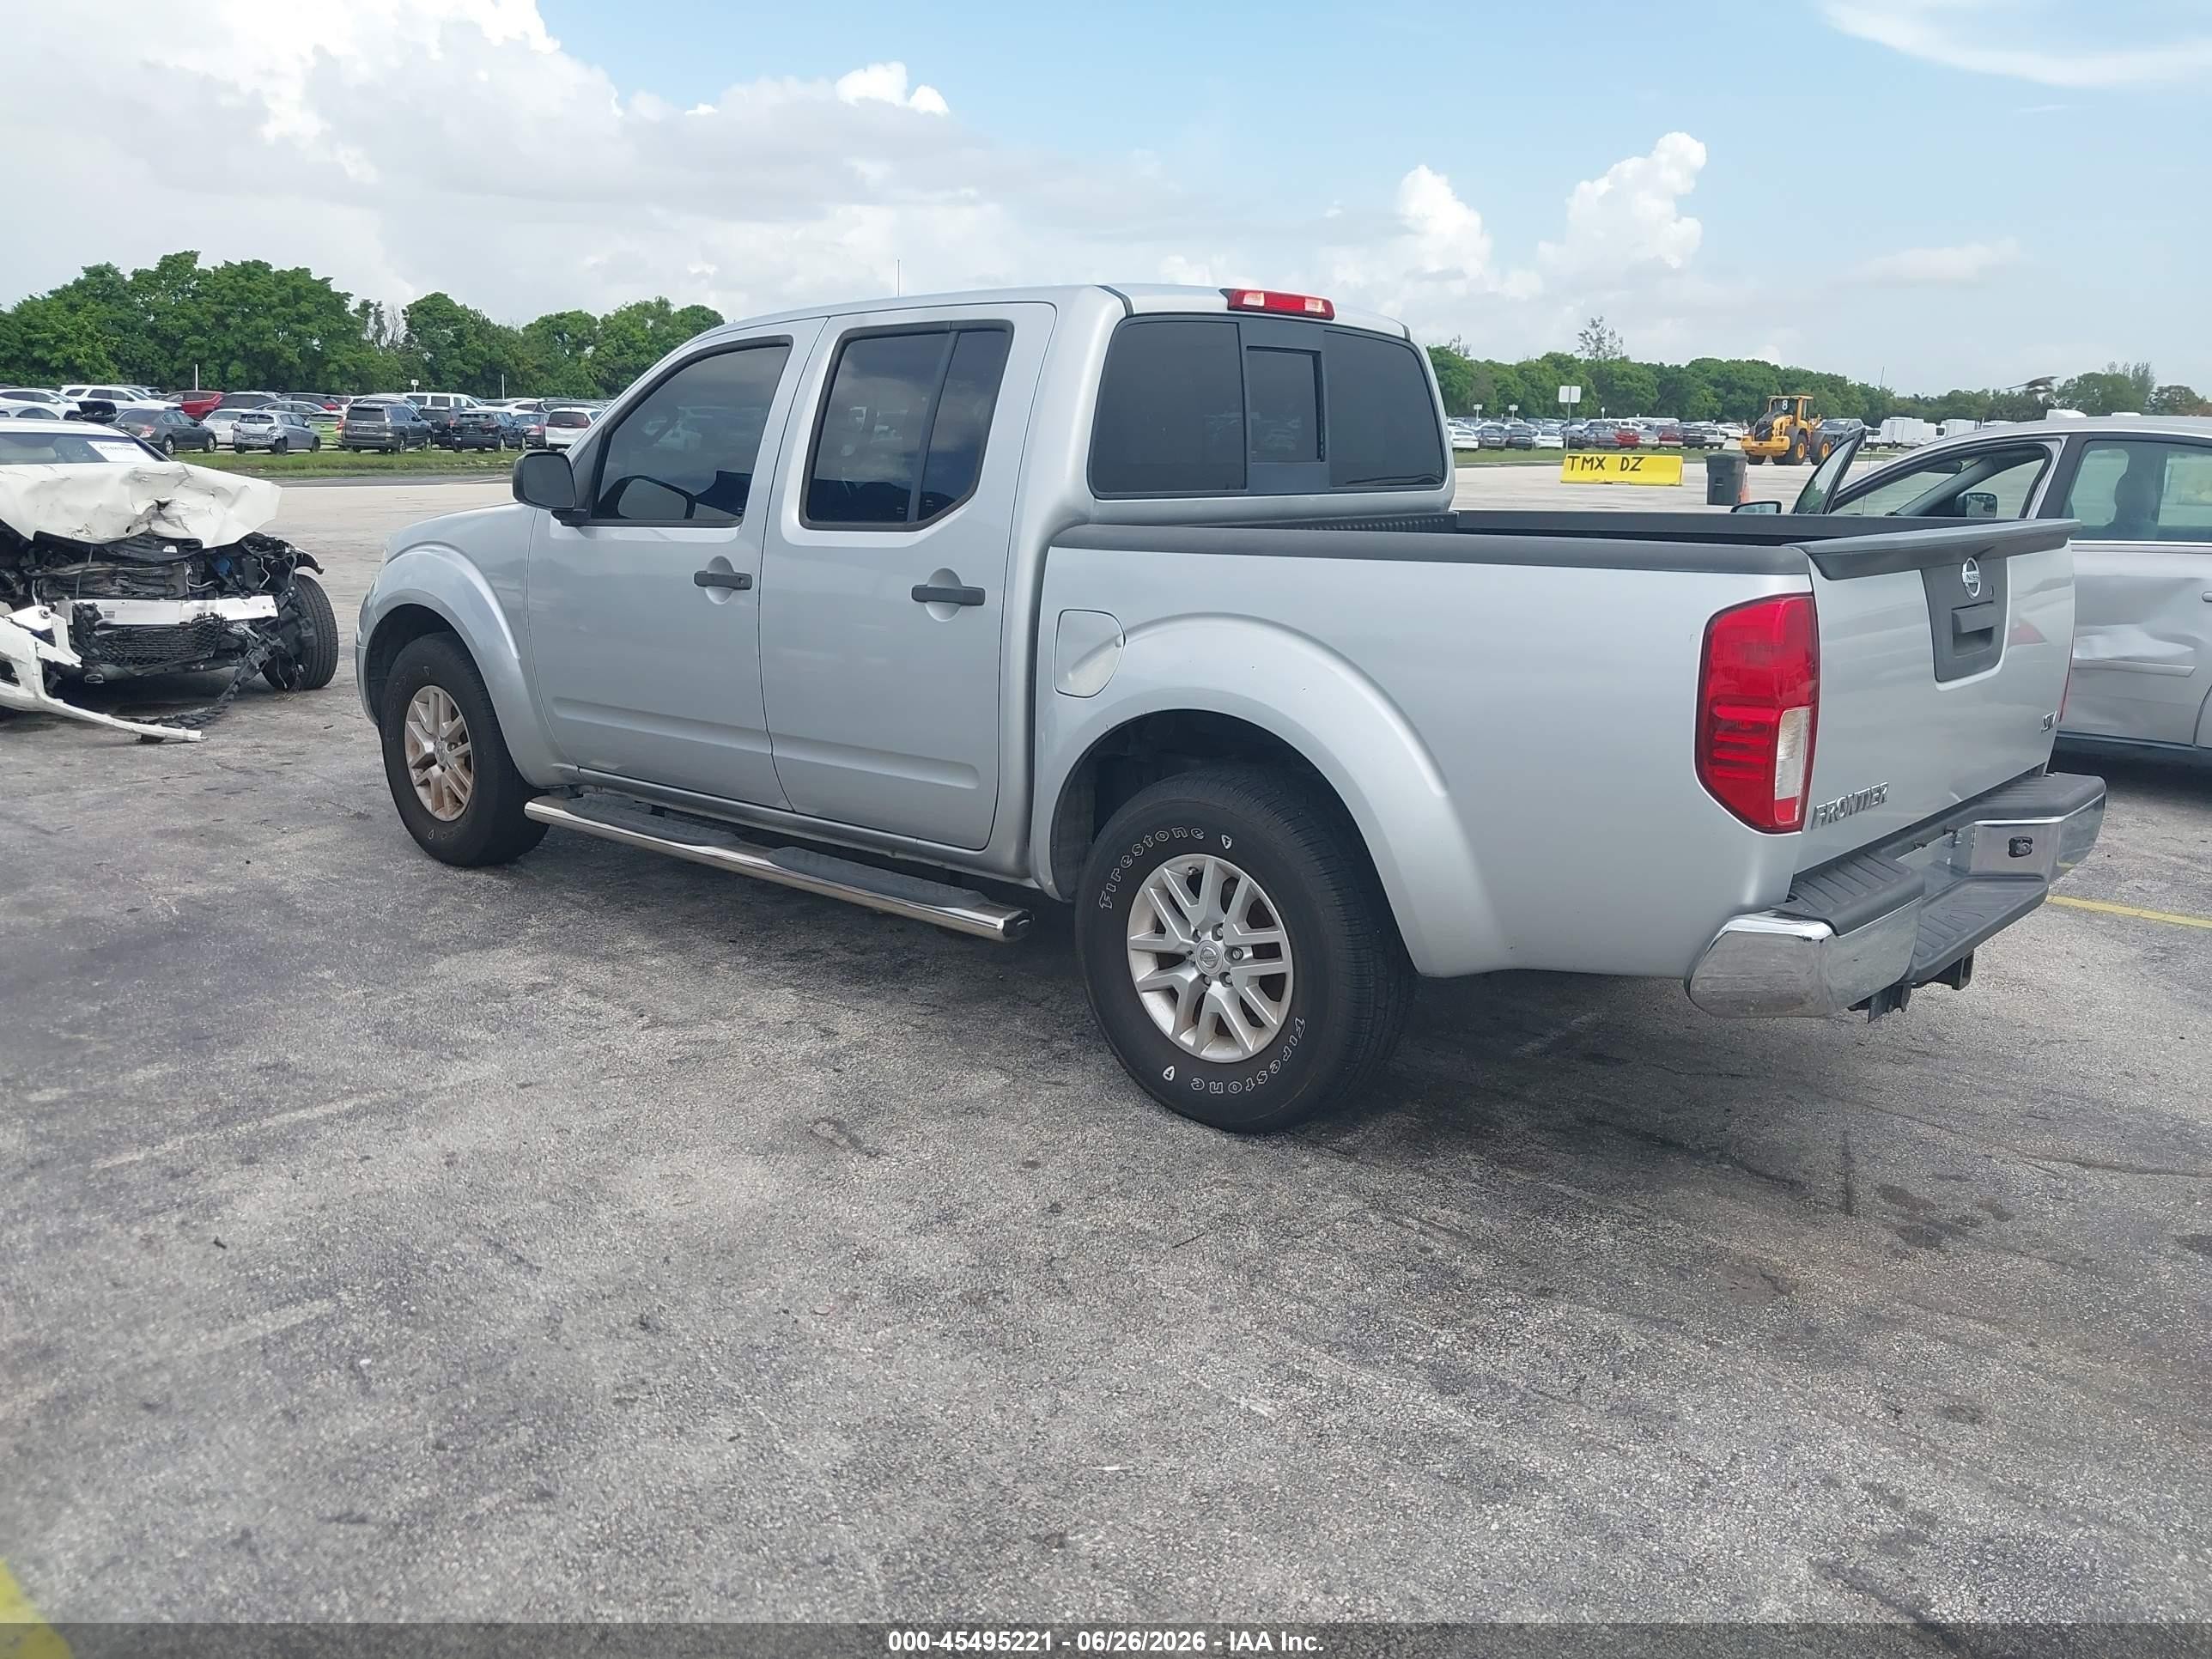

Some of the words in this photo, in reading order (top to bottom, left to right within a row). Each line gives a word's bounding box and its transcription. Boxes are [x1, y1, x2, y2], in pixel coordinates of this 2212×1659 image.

[1781, 399, 1789, 410] 8
[1567, 455, 1607, 471] TMX
[1620, 456, 1646, 472] DZ
[1811, 781, 1889, 830] FRONTIER
[1098, 825, 1205, 910] Firestone
[1190, 1017, 1306, 1094] Firestone
